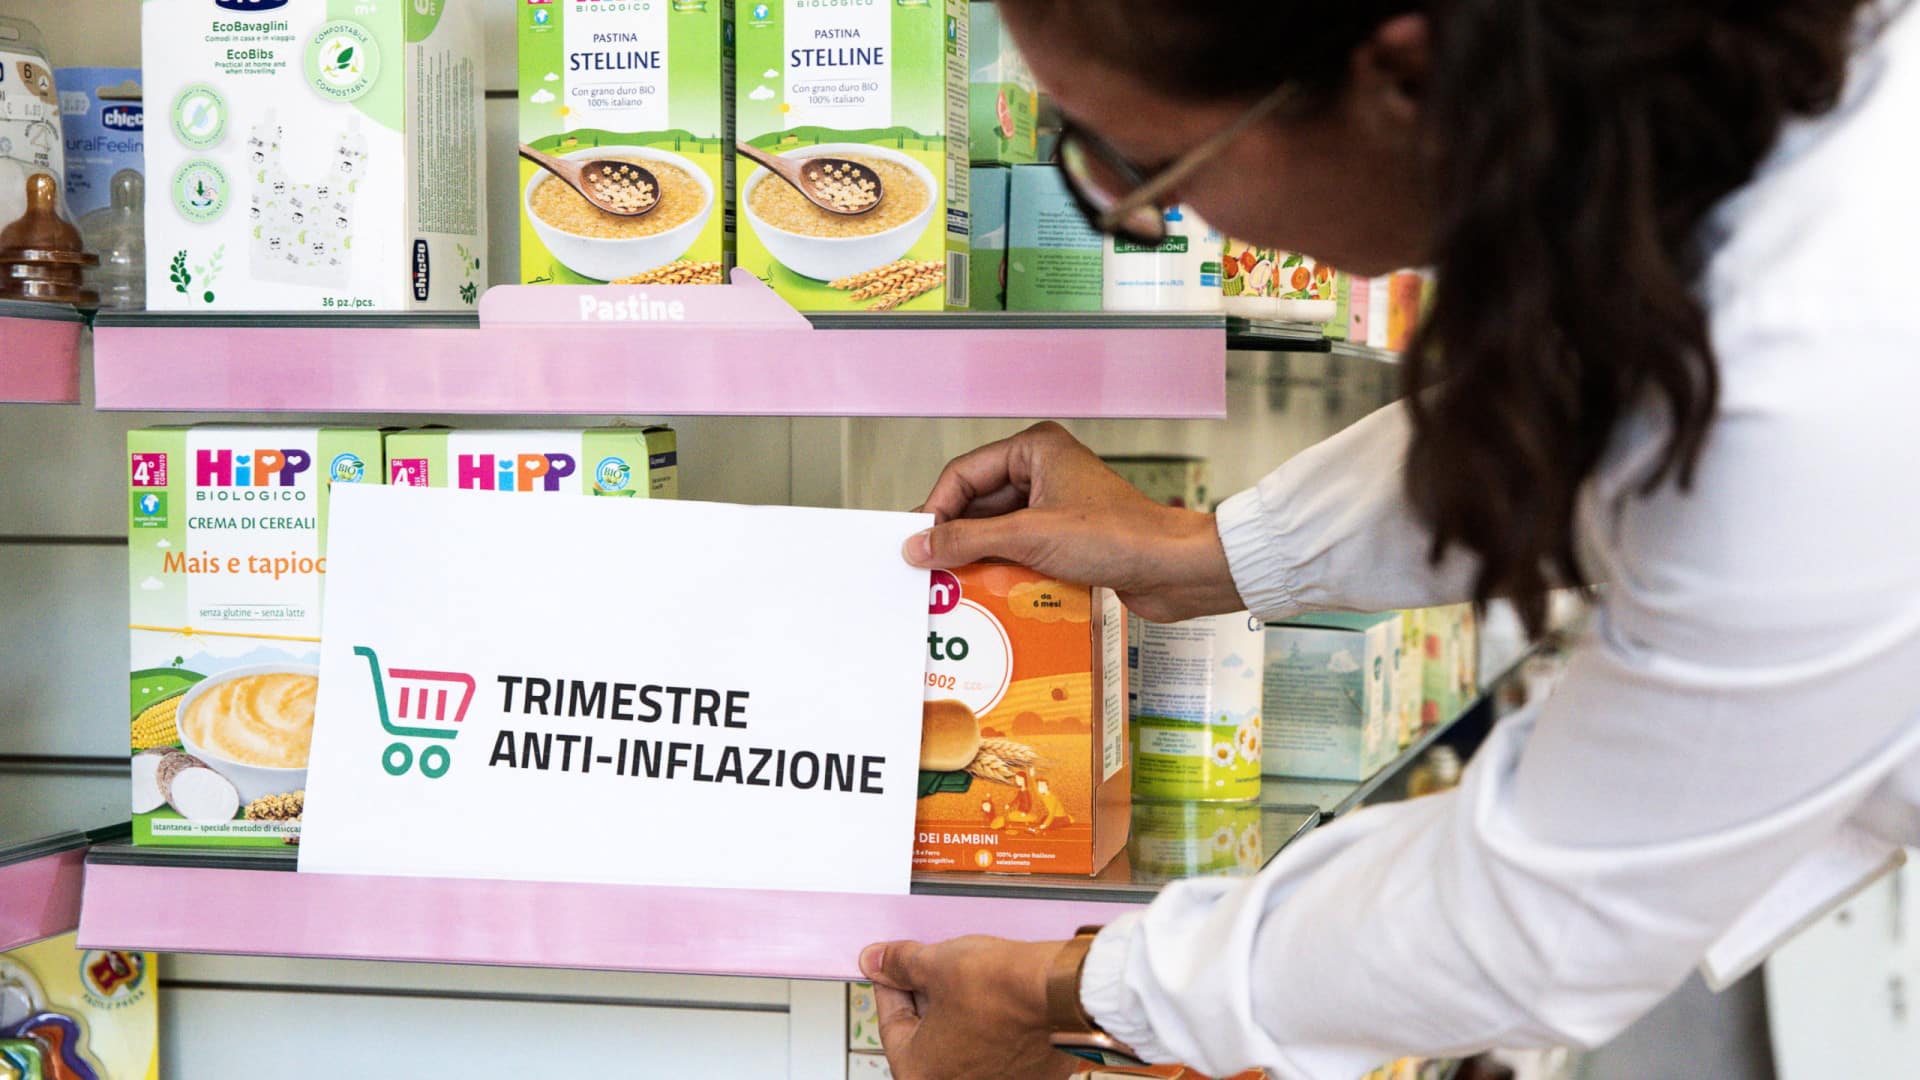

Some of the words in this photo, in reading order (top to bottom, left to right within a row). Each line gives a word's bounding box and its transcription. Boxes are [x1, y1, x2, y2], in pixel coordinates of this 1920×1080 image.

[576, 3, 650, 12] BIOLOGICO
[212, 20, 288, 33] EcoBavaglini
[315, 25, 368, 44] COMPOSTABILE
[593, 32, 638, 43] PASTINA
[814, 29, 860, 39] PASTINA
[227, 48, 274, 60] EcoBibs
[791, 47, 884, 67] STELLINE
[569, 51, 661, 71] STELLINE
[24, 64, 32, 79] 6
[316, 78, 368, 96] COMPOSTABLE
[571, 87, 589, 96] Con
[591, 88, 615, 97] grano
[617, 86, 637, 95] duro
[639, 86, 655, 95] BIO
[792, 84, 810, 93] Con
[812, 84, 837, 94] grano
[838, 83, 859, 92] duro
[862, 82, 878, 91] BIO
[587, 98, 609, 107] 100%
[611, 98, 642, 106] italiano
[808, 95, 830, 104] 100%
[832, 94, 865, 104] italiano
[413, 243, 427, 298] chicco
[323, 297, 334, 307] 36
[579, 291, 685, 321] Pastine
[196, 449, 311, 487] HiPP
[338, 464, 356, 475] BIO
[458, 453, 576, 492] HiPP
[603, 467, 622, 479] BIO
[196, 490, 306, 501] BIOLOGICO
[188, 516, 237, 530] CREMA
[241, 517, 255, 529] DI
[259, 516, 315, 529] CEREALI
[163, 550, 220, 574] Mais
[227, 556, 240, 574] e
[1033, 600, 1039, 608] 6
[1040, 600, 1061, 608] mesi
[200, 608, 221, 617] senza
[223, 607, 252, 619] glutine
[261, 608, 284, 617] senza
[286, 607, 305, 617] latte
[497, 674, 750, 729] TRIMESTRE
[488, 730, 886, 795] ANTI-INFLAZIONE
[153, 823, 192, 831] istantanea
[200, 823, 231, 833] speciale
[232, 824, 262, 832] metodo
[263, 823, 271, 832] di
[919, 833, 939, 843] DEI
[943, 833, 998, 845] BAMBINI
